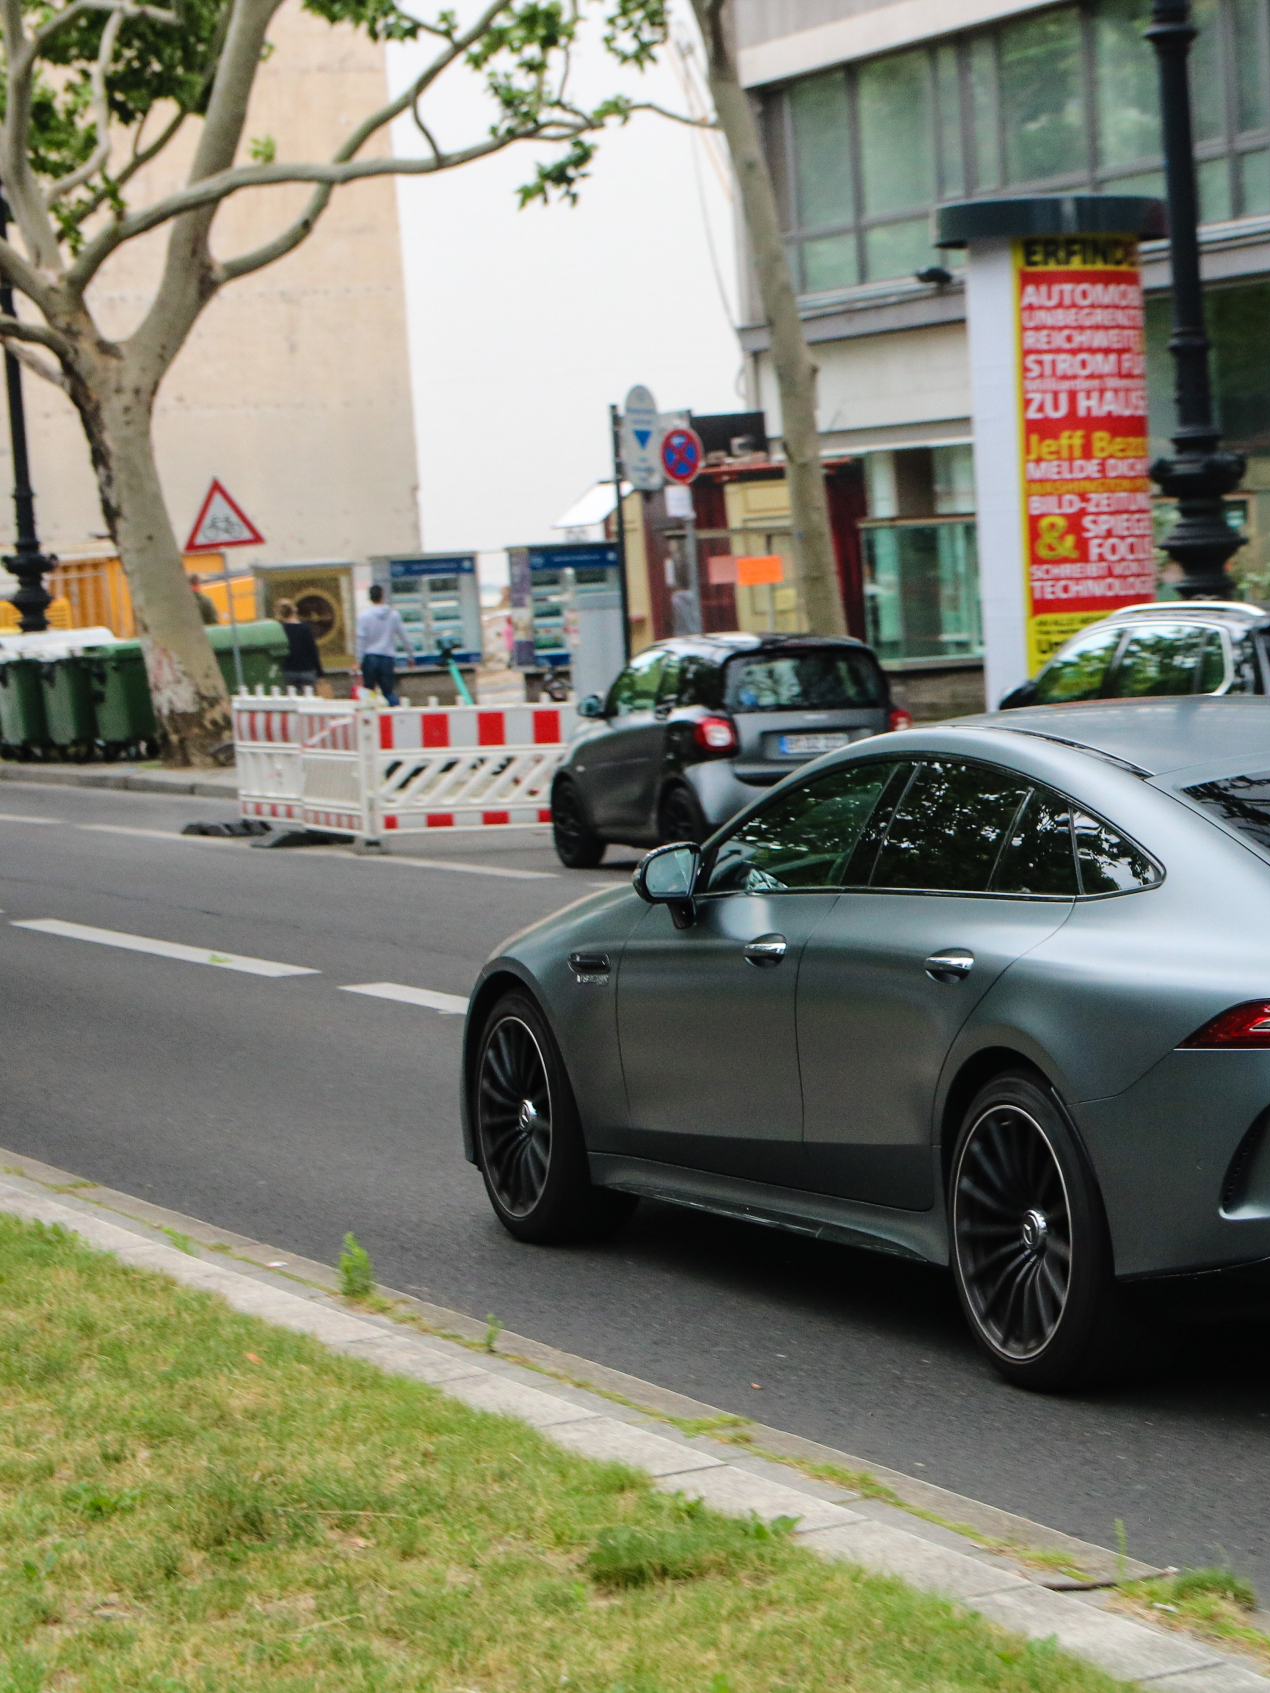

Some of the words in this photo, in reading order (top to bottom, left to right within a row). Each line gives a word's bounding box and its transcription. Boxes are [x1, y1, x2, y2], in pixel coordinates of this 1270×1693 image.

[1024, 352, 1118, 378] STROM
[1025, 391, 1070, 419] ZU
[1026, 429, 1086, 460] Jeff
[1036, 515, 1079, 560] &
